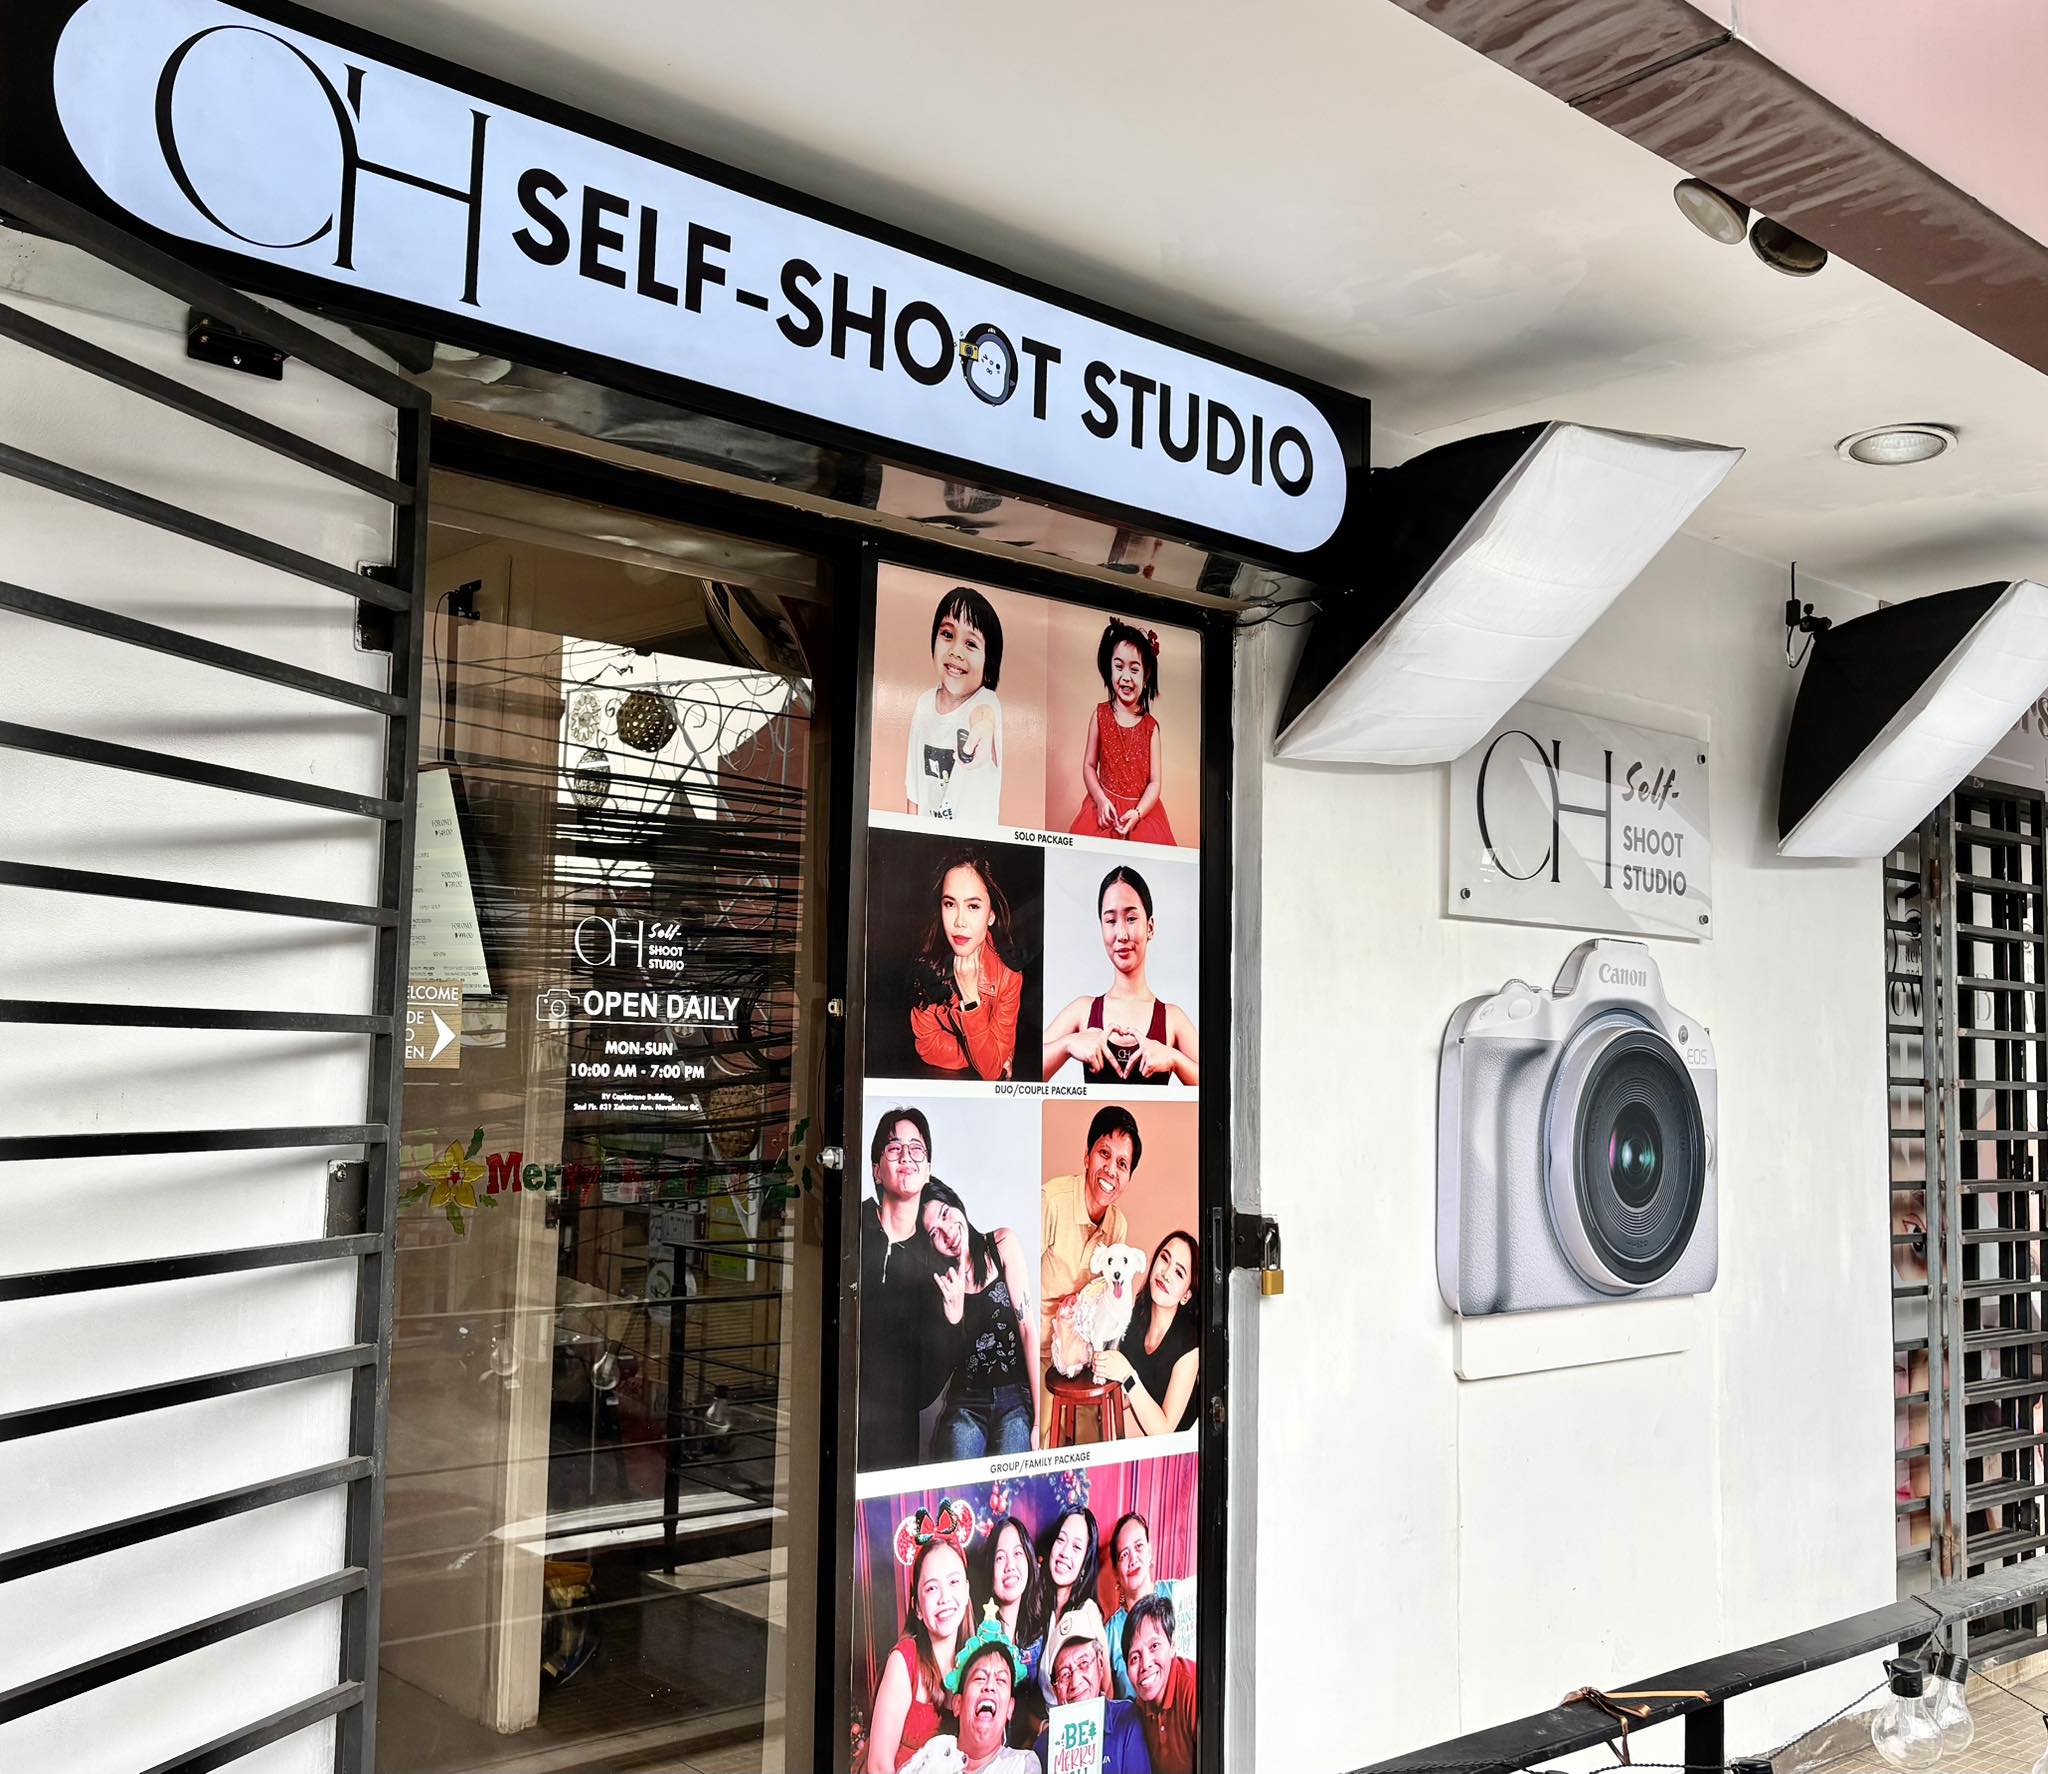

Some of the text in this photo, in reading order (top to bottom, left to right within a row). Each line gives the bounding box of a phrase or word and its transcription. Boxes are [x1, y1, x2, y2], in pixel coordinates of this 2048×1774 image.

[512, 168, 1314, 497] SELF-SHOOT STUDIO
[1622, 761, 1680, 811] Self-
[1014, 831, 1074, 847] SOLO PACKAGE
[1623, 825, 1684, 858] SHOOT
[1622, 864, 1687, 896] STUDIO
[648, 922, 682, 941] Self-
[648, 945, 684, 957] SHOOT
[648, 958, 685, 971] STUDIO
[1599, 963, 1647, 987] Canon
[583, 990, 740, 1021] OPEN DAILY
[604, 1040, 674, 1056] MON-SUN
[1687, 1048, 1707, 1065] EOS
[570, 1063, 610, 1077] 10:00
[613, 1064, 637, 1078] AM
[650, 1065, 680, 1079] 7:00
[684, 1065, 705, 1079] PM
[994, 1084, 1088, 1097] DUO/COUPLE PACKAGE
[990, 1451, 1091, 1473] GROUP/FAMILY PACKAGE
[1064, 1720, 1090, 1749] BE
